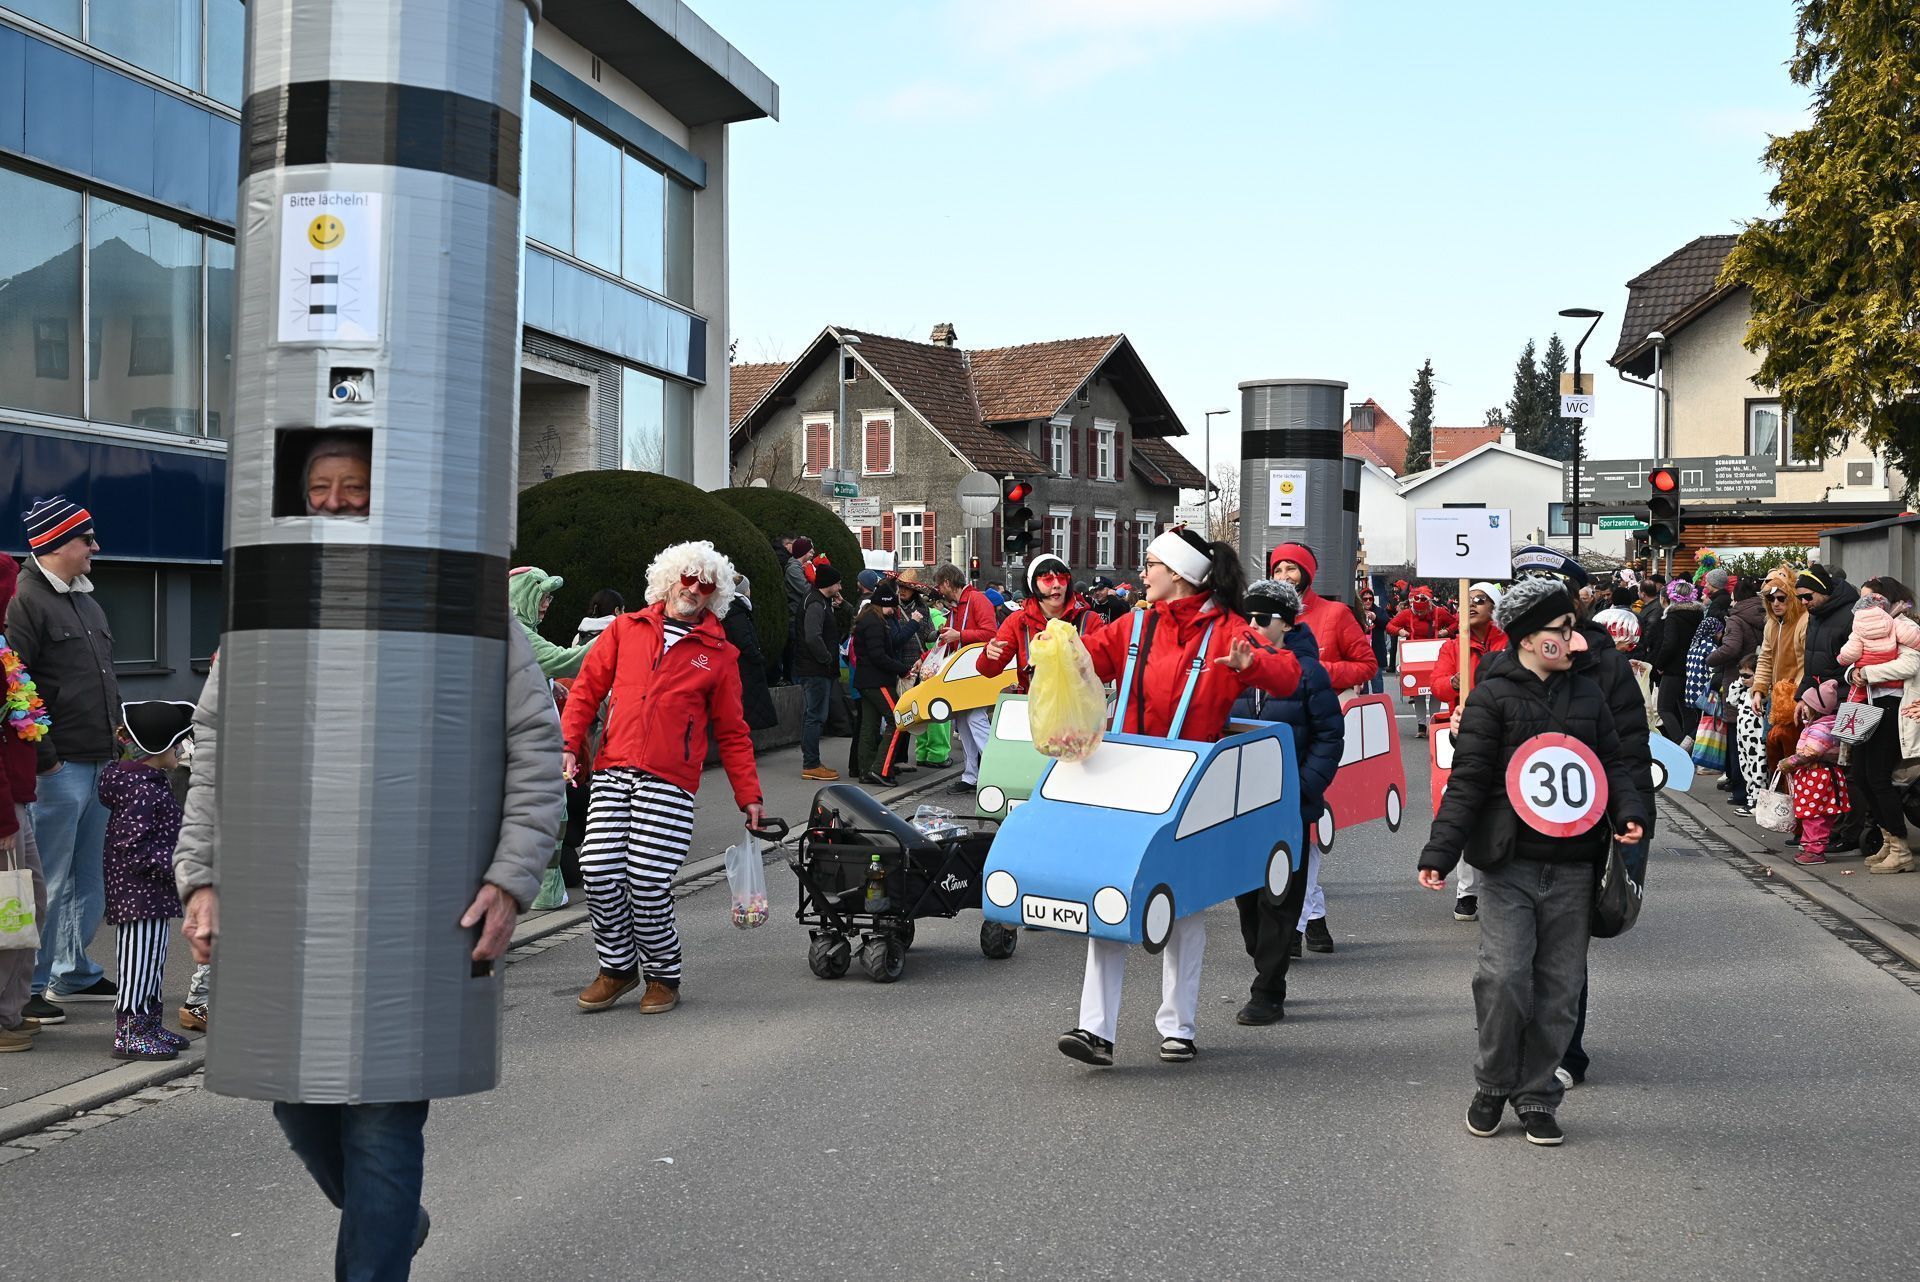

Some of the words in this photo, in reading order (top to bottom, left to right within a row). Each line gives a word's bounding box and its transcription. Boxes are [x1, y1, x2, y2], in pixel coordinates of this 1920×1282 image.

[290, 195, 315, 207] Bitte
[318, 193, 369, 206] lächeln!
[1566, 402, 1589, 413] WC
[1600, 519, 1639, 528] Sportzentrum
[1456, 533, 1470, 557] 5
[1543, 642, 1558, 654] 30
[1529, 761, 1588, 809] 30
[1027, 904, 1046, 919] LU
[1053, 907, 1083, 925] KPV
